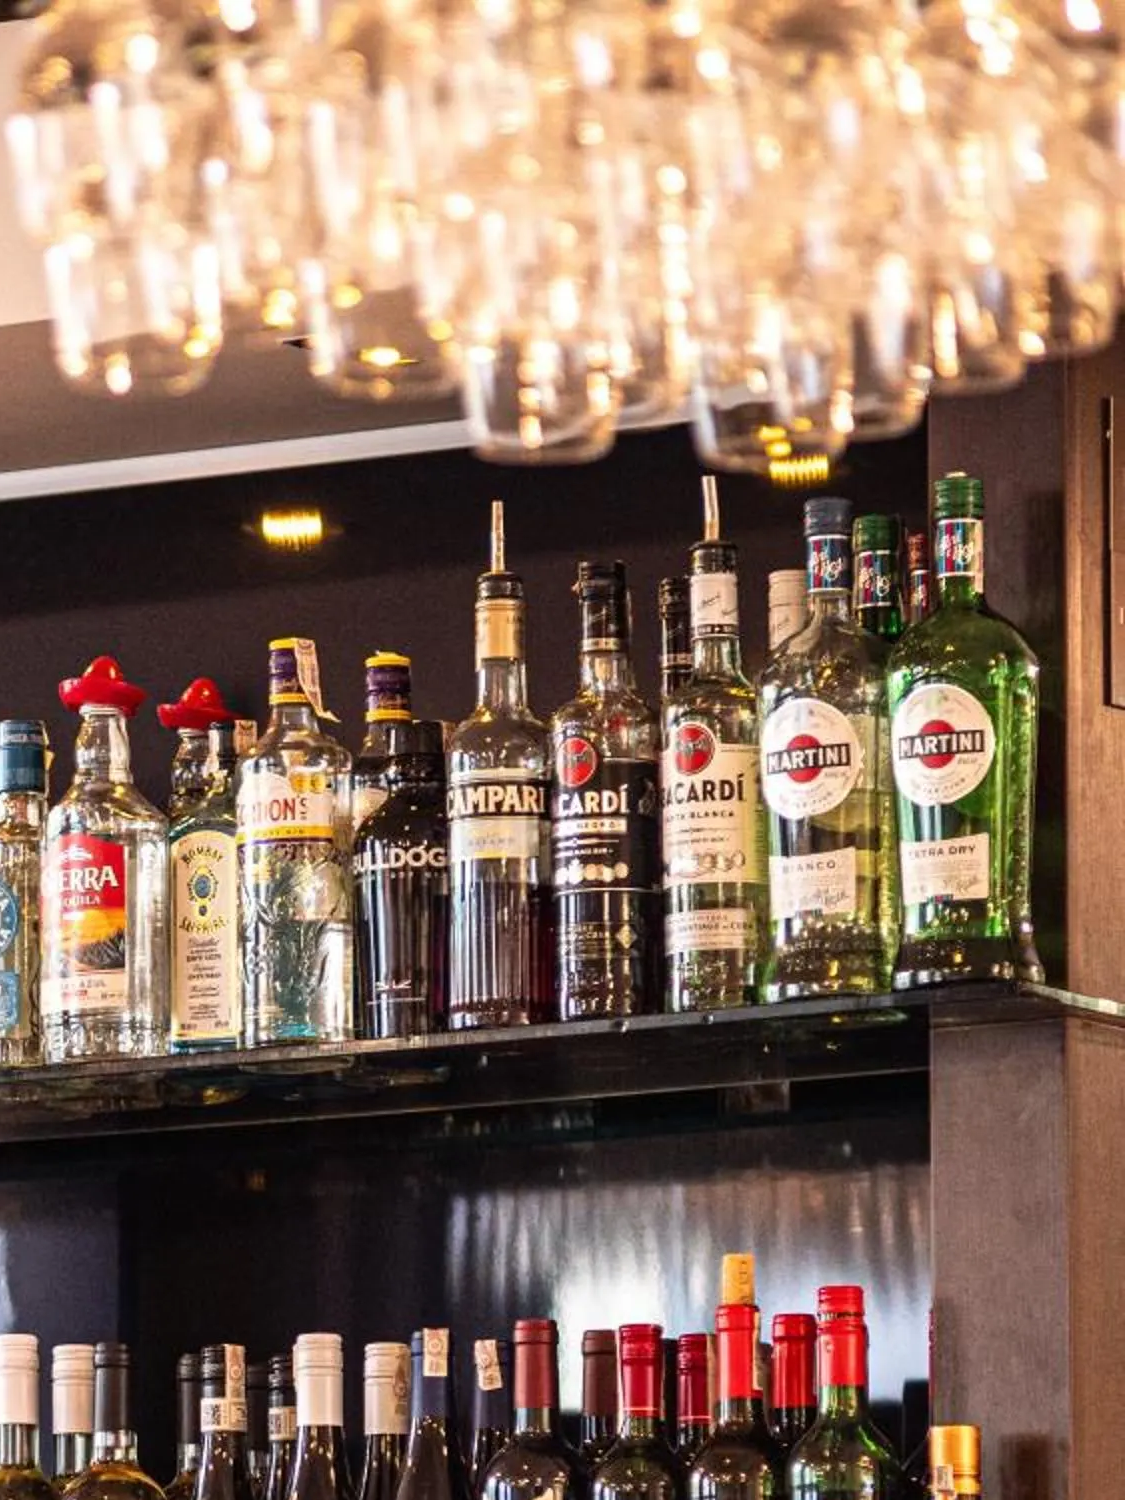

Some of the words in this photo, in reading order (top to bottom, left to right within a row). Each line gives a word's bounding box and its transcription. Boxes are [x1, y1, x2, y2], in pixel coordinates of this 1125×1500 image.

[768, 745, 849, 772] MARTINI
[900, 731, 983, 759] MARTINI
[447, 784, 544, 818] CAMPARI
[180, 847, 224, 868] BOMBAY
[947, 845, 976, 857] DRY
